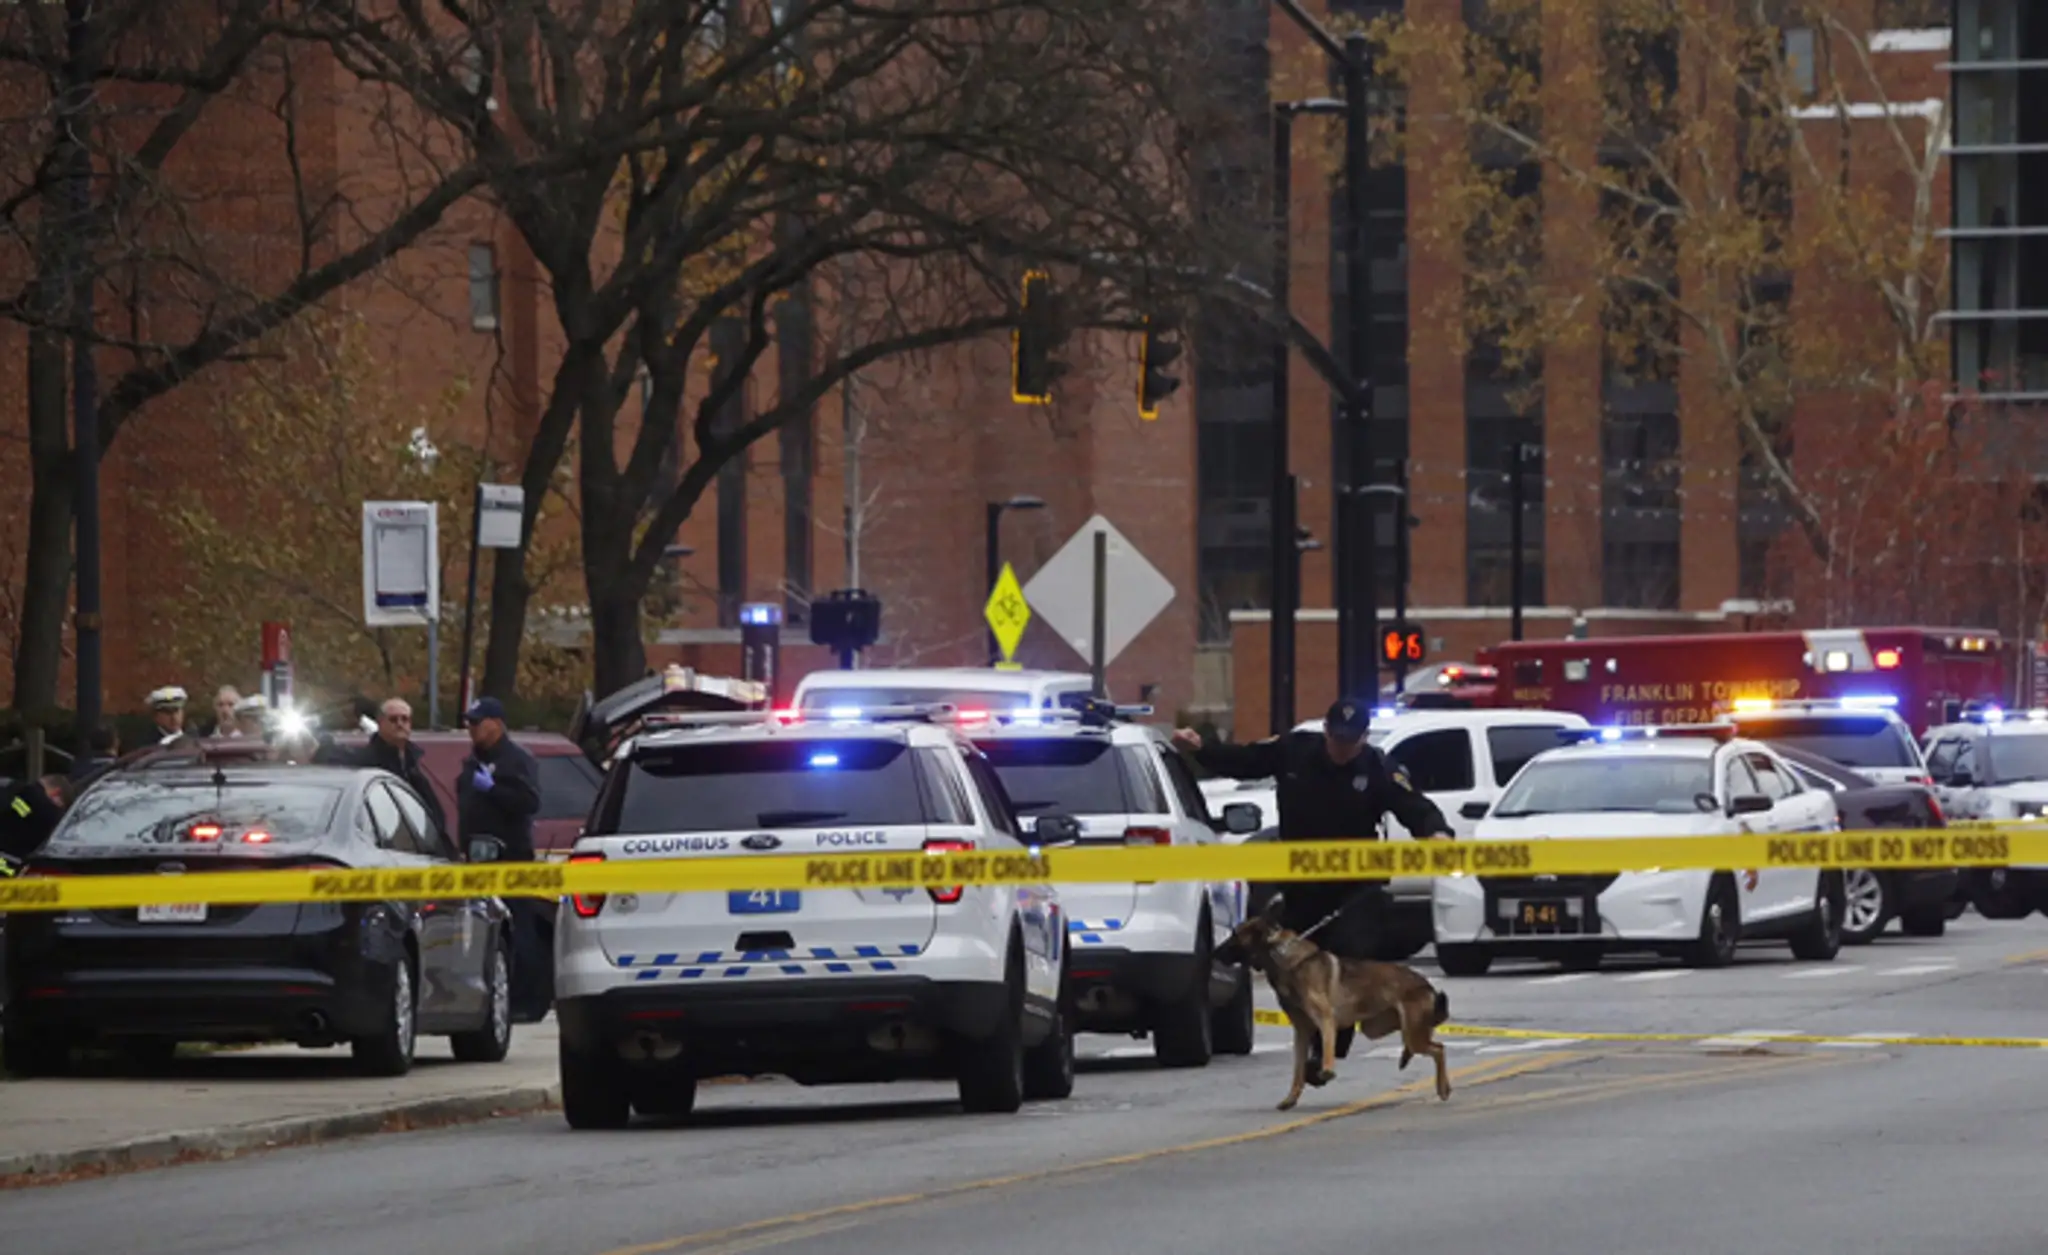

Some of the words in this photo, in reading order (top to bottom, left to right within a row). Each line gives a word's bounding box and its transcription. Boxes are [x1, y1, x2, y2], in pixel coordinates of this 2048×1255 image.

[1406, 633, 1421, 659] 6
[1601, 684, 1693, 703] FRANKLIN
[623, 837, 730, 854] COLUMBUS
[816, 830, 887, 847] POLICE
[1767, 838, 1829, 863] POLICE
[1835, 838, 1874, 861] LINE
[1879, 836, 1904, 860] DO
[1910, 836, 1946, 859] NOT
[1952, 834, 2010, 860] CROSS
[806, 859, 869, 884] POLICE
[875, 858, 915, 882] LINE
[921, 857, 947, 881] DO
[952, 857, 987, 880] NOT
[992, 854, 1051, 880] CROSS
[1289, 849, 1350, 873] POLICE
[1357, 848, 1396, 872] LINE
[1402, 847, 1427, 870] DO
[1432, 846, 1467, 870] NOT
[1471, 844, 1532, 869] CROSS
[311, 873, 376, 896] POLICE
[381, 872, 424, 893] LINE
[430, 871, 455, 891] DO
[461, 869, 499, 891] NOT
[503, 867, 564, 890] CROSS
[748, 889, 782, 908] 41
